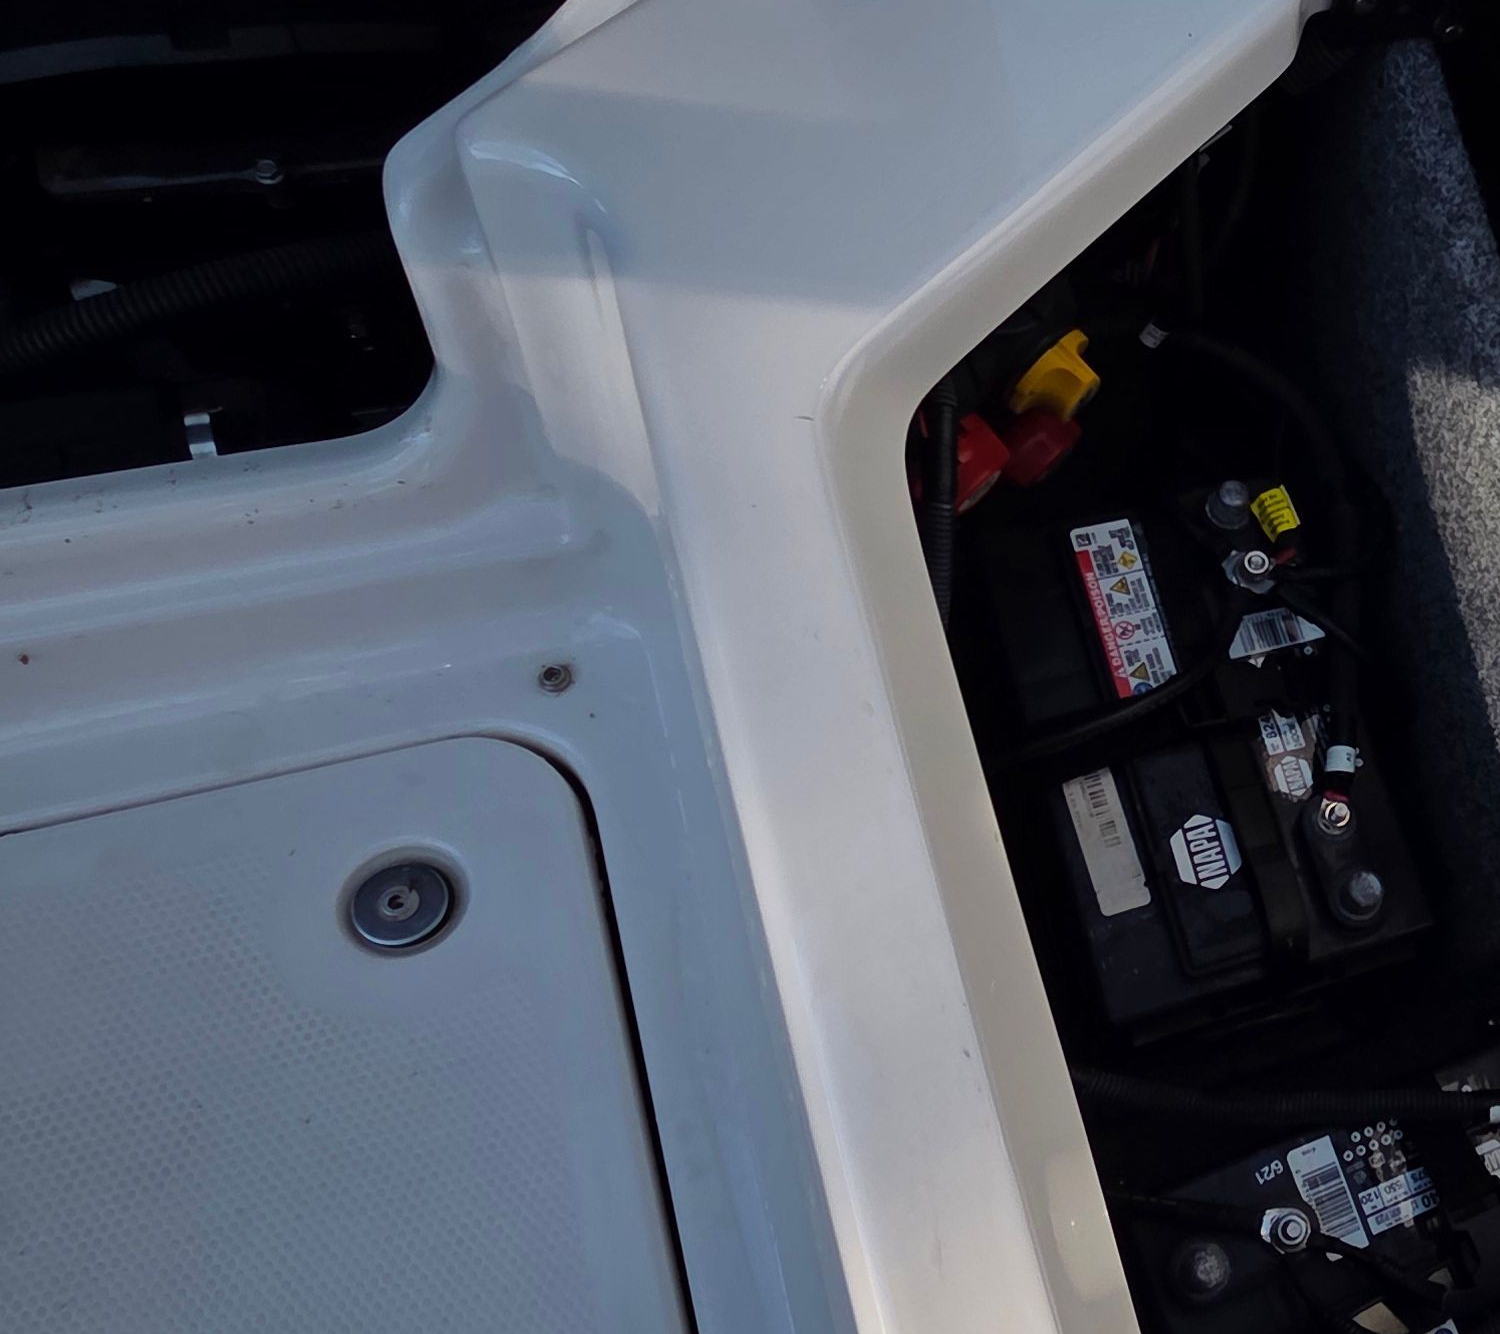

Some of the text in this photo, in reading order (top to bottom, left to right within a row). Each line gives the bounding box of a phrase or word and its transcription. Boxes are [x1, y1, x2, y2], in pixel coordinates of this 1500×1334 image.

[1282, 761, 1304, 789] NAPA
[1185, 822, 1227, 879] NAPA
[1253, 1158, 1284, 1185] 6/21
